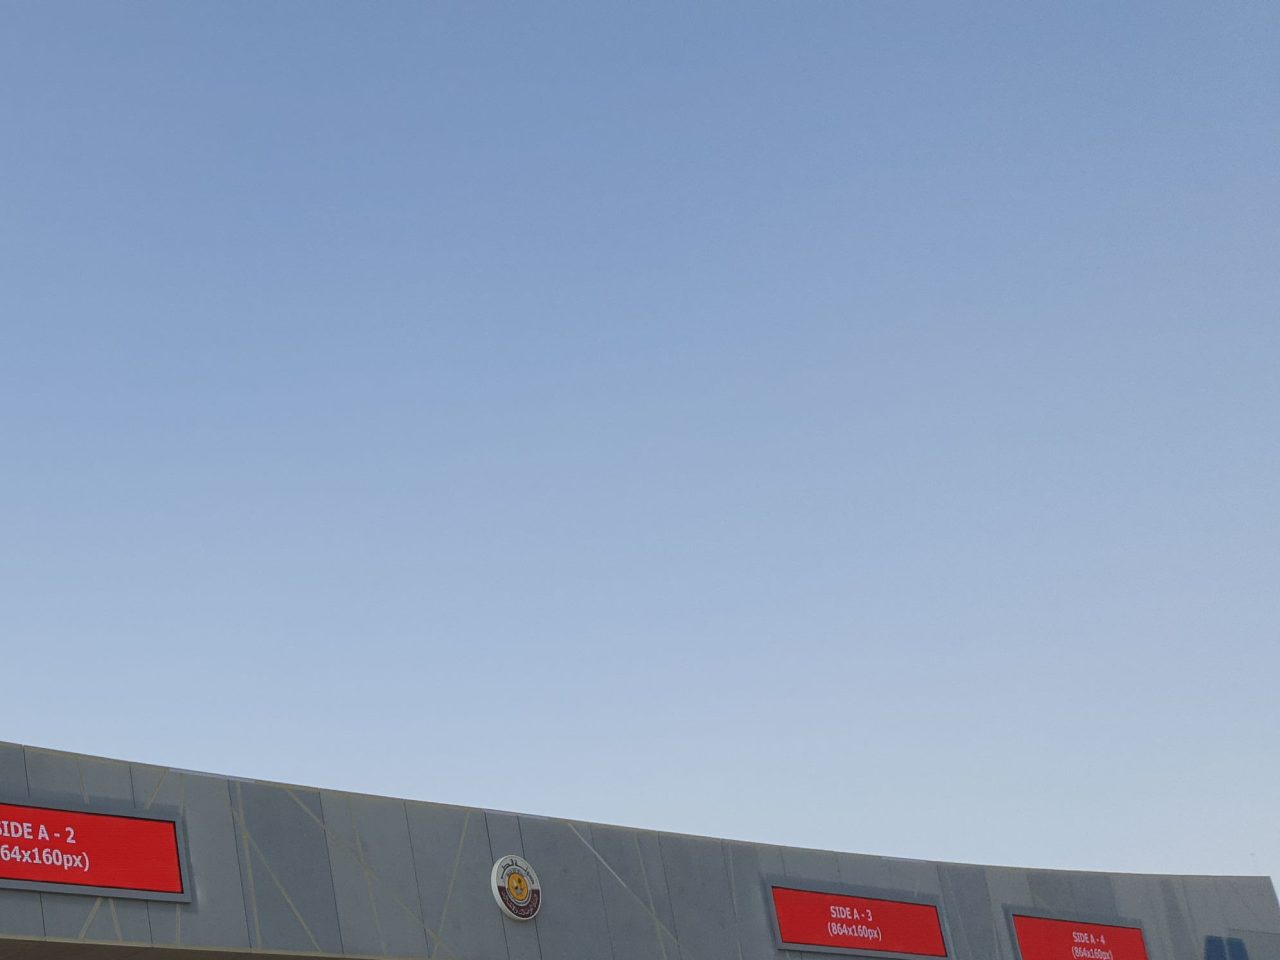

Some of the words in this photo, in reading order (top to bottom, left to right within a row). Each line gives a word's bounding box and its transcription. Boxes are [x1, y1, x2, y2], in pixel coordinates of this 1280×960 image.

[38, 824, 49, 841] A
[65, 826, 76, 844] 2
[830, 905, 852, 920] SIDE
[853, 908, 860, 920] A
[865, 909, 873, 922] 3
[827, 921, 882, 942] (864x160px)
[1072, 931, 1090, 943] SIDE
[1090, 934, 1096, 944] A
